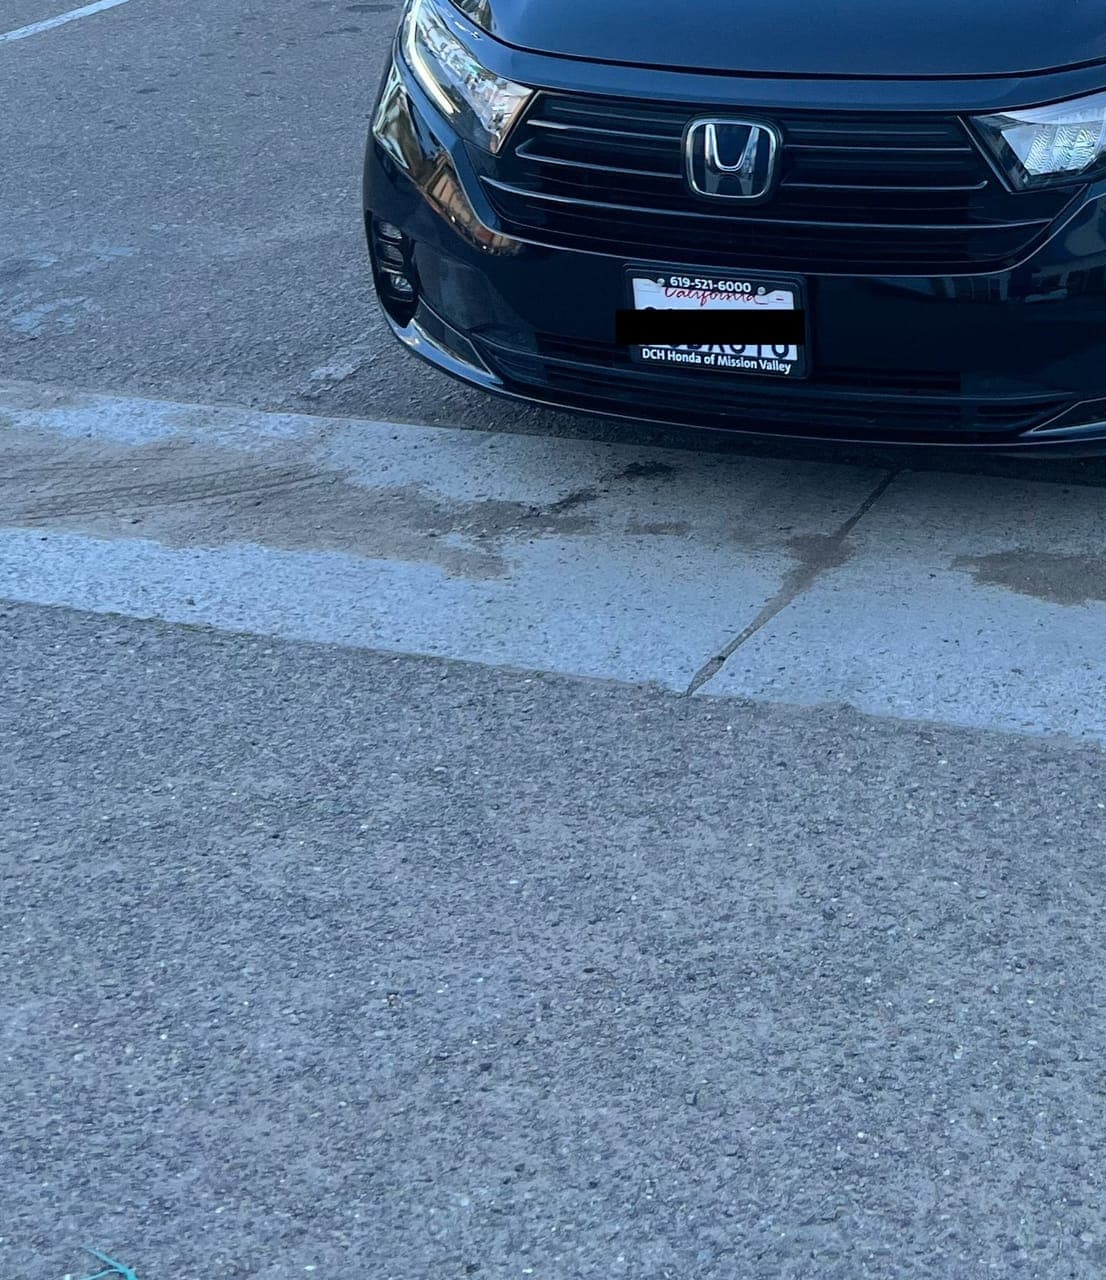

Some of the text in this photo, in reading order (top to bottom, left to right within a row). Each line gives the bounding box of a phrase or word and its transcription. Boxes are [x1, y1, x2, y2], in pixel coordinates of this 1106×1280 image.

[670, 276, 752, 293] 619-521-6000
[642, 348, 665, 361] DCH
[667, 350, 702, 364] Honda
[703, 353, 716, 365] of
[717, 354, 758, 370] Mission
[758, 359, 792, 375] Valley
